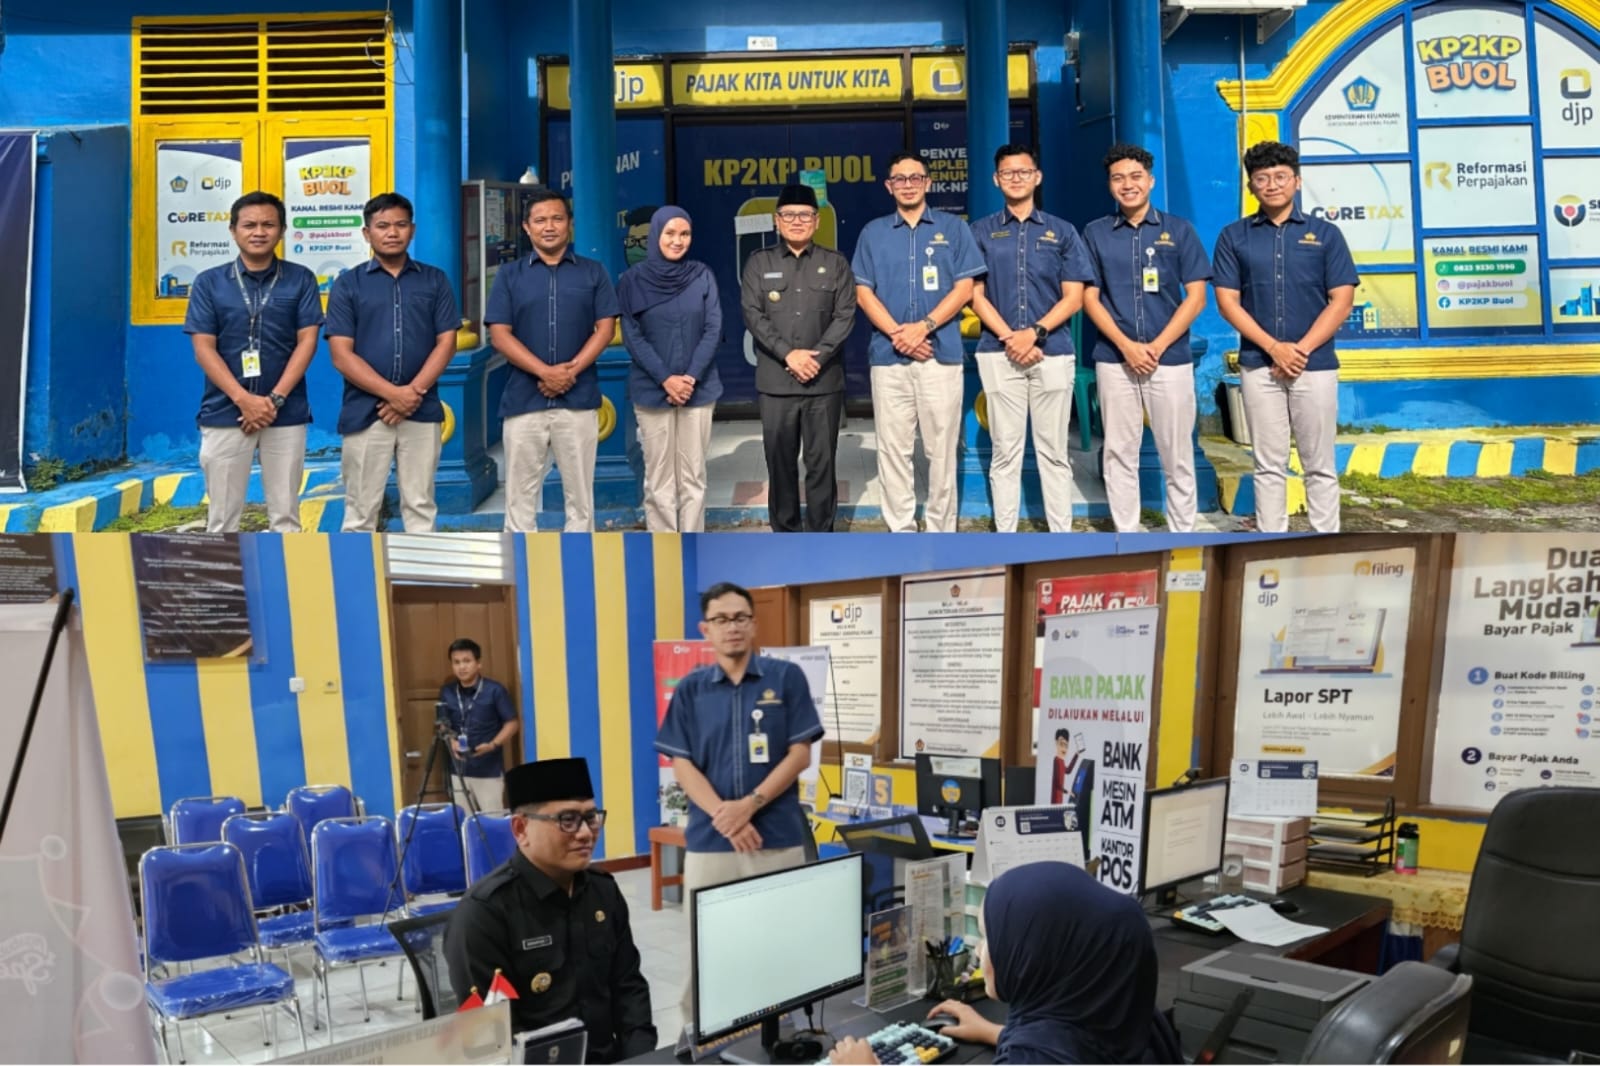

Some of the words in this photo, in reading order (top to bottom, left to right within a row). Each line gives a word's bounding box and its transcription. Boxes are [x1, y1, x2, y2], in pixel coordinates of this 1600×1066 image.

[1417, 35, 1521, 63] KP2KP
[686, 74, 739, 92] PAJAK
[744, 72, 782, 92] KITA
[787, 70, 848, 90] UNTUK
[852, 69, 891, 88] KITA
[1426, 61, 1516, 92] BUOL
[614, 71, 644, 101] jp
[1561, 103, 1593, 125] djp
[299, 165, 356, 180] KP2KP
[703, 158, 797, 186] KP2KP
[803, 155, 876, 183] BUOL
[1456, 162, 1527, 176] Reformasi
[215, 177, 231, 190] djp
[303, 180, 352, 197] BUOL
[1456, 175, 1528, 189] Perpajakan
[319, 204, 342, 212] RESMI
[1311, 205, 1404, 221] CORETAX
[167, 211, 231, 223] CORETAX
[190, 240, 230, 248] Reformasi
[1432, 246, 1465, 255] KANAL
[1469, 245, 1500, 254] RESMI
[1502, 244, 1528, 253] KAMI
[190, 248, 230, 257] Perpajakan
[1457, 280, 1513, 291] @pajakbuol
[1458, 297, 1490, 305] KP2KP
[1492, 296, 1514, 304] Buol
[1547, 547, 1600, 570] Dua
[1474, 570, 1600, 600] Langkah
[1060, 593, 1104, 609] PAJAK
[1257, 591, 1279, 607] djp
[844, 602, 862, 622] djp
[1499, 595, 1600, 621] Mudah
[1484, 623, 1527, 637] Bayar
[1531, 622, 1574, 636] Pajak
[1494, 671, 1518, 680] Buat
[1520, 671, 1547, 680] Kode
[1549, 671, 1585, 681] Billing
[1050, 674, 1092, 699] BAYAR
[1097, 673, 1145, 700] PAJAK
[1264, 688, 1314, 706] Lapor
[1317, 688, 1353, 704] SPT
[1102, 709, 1144, 722] MELALUI
[1103, 740, 1142, 771] BANK
[1488, 752, 1517, 762] Bayar
[1520, 754, 1549, 763] Pajak
[1552, 756, 1579, 765] Anda
[1103, 779, 1136, 802] MESIN
[1101, 800, 1134, 830] ATM
[1101, 838, 1134, 858] KANTOR
[1101, 855, 1132, 889] POS
